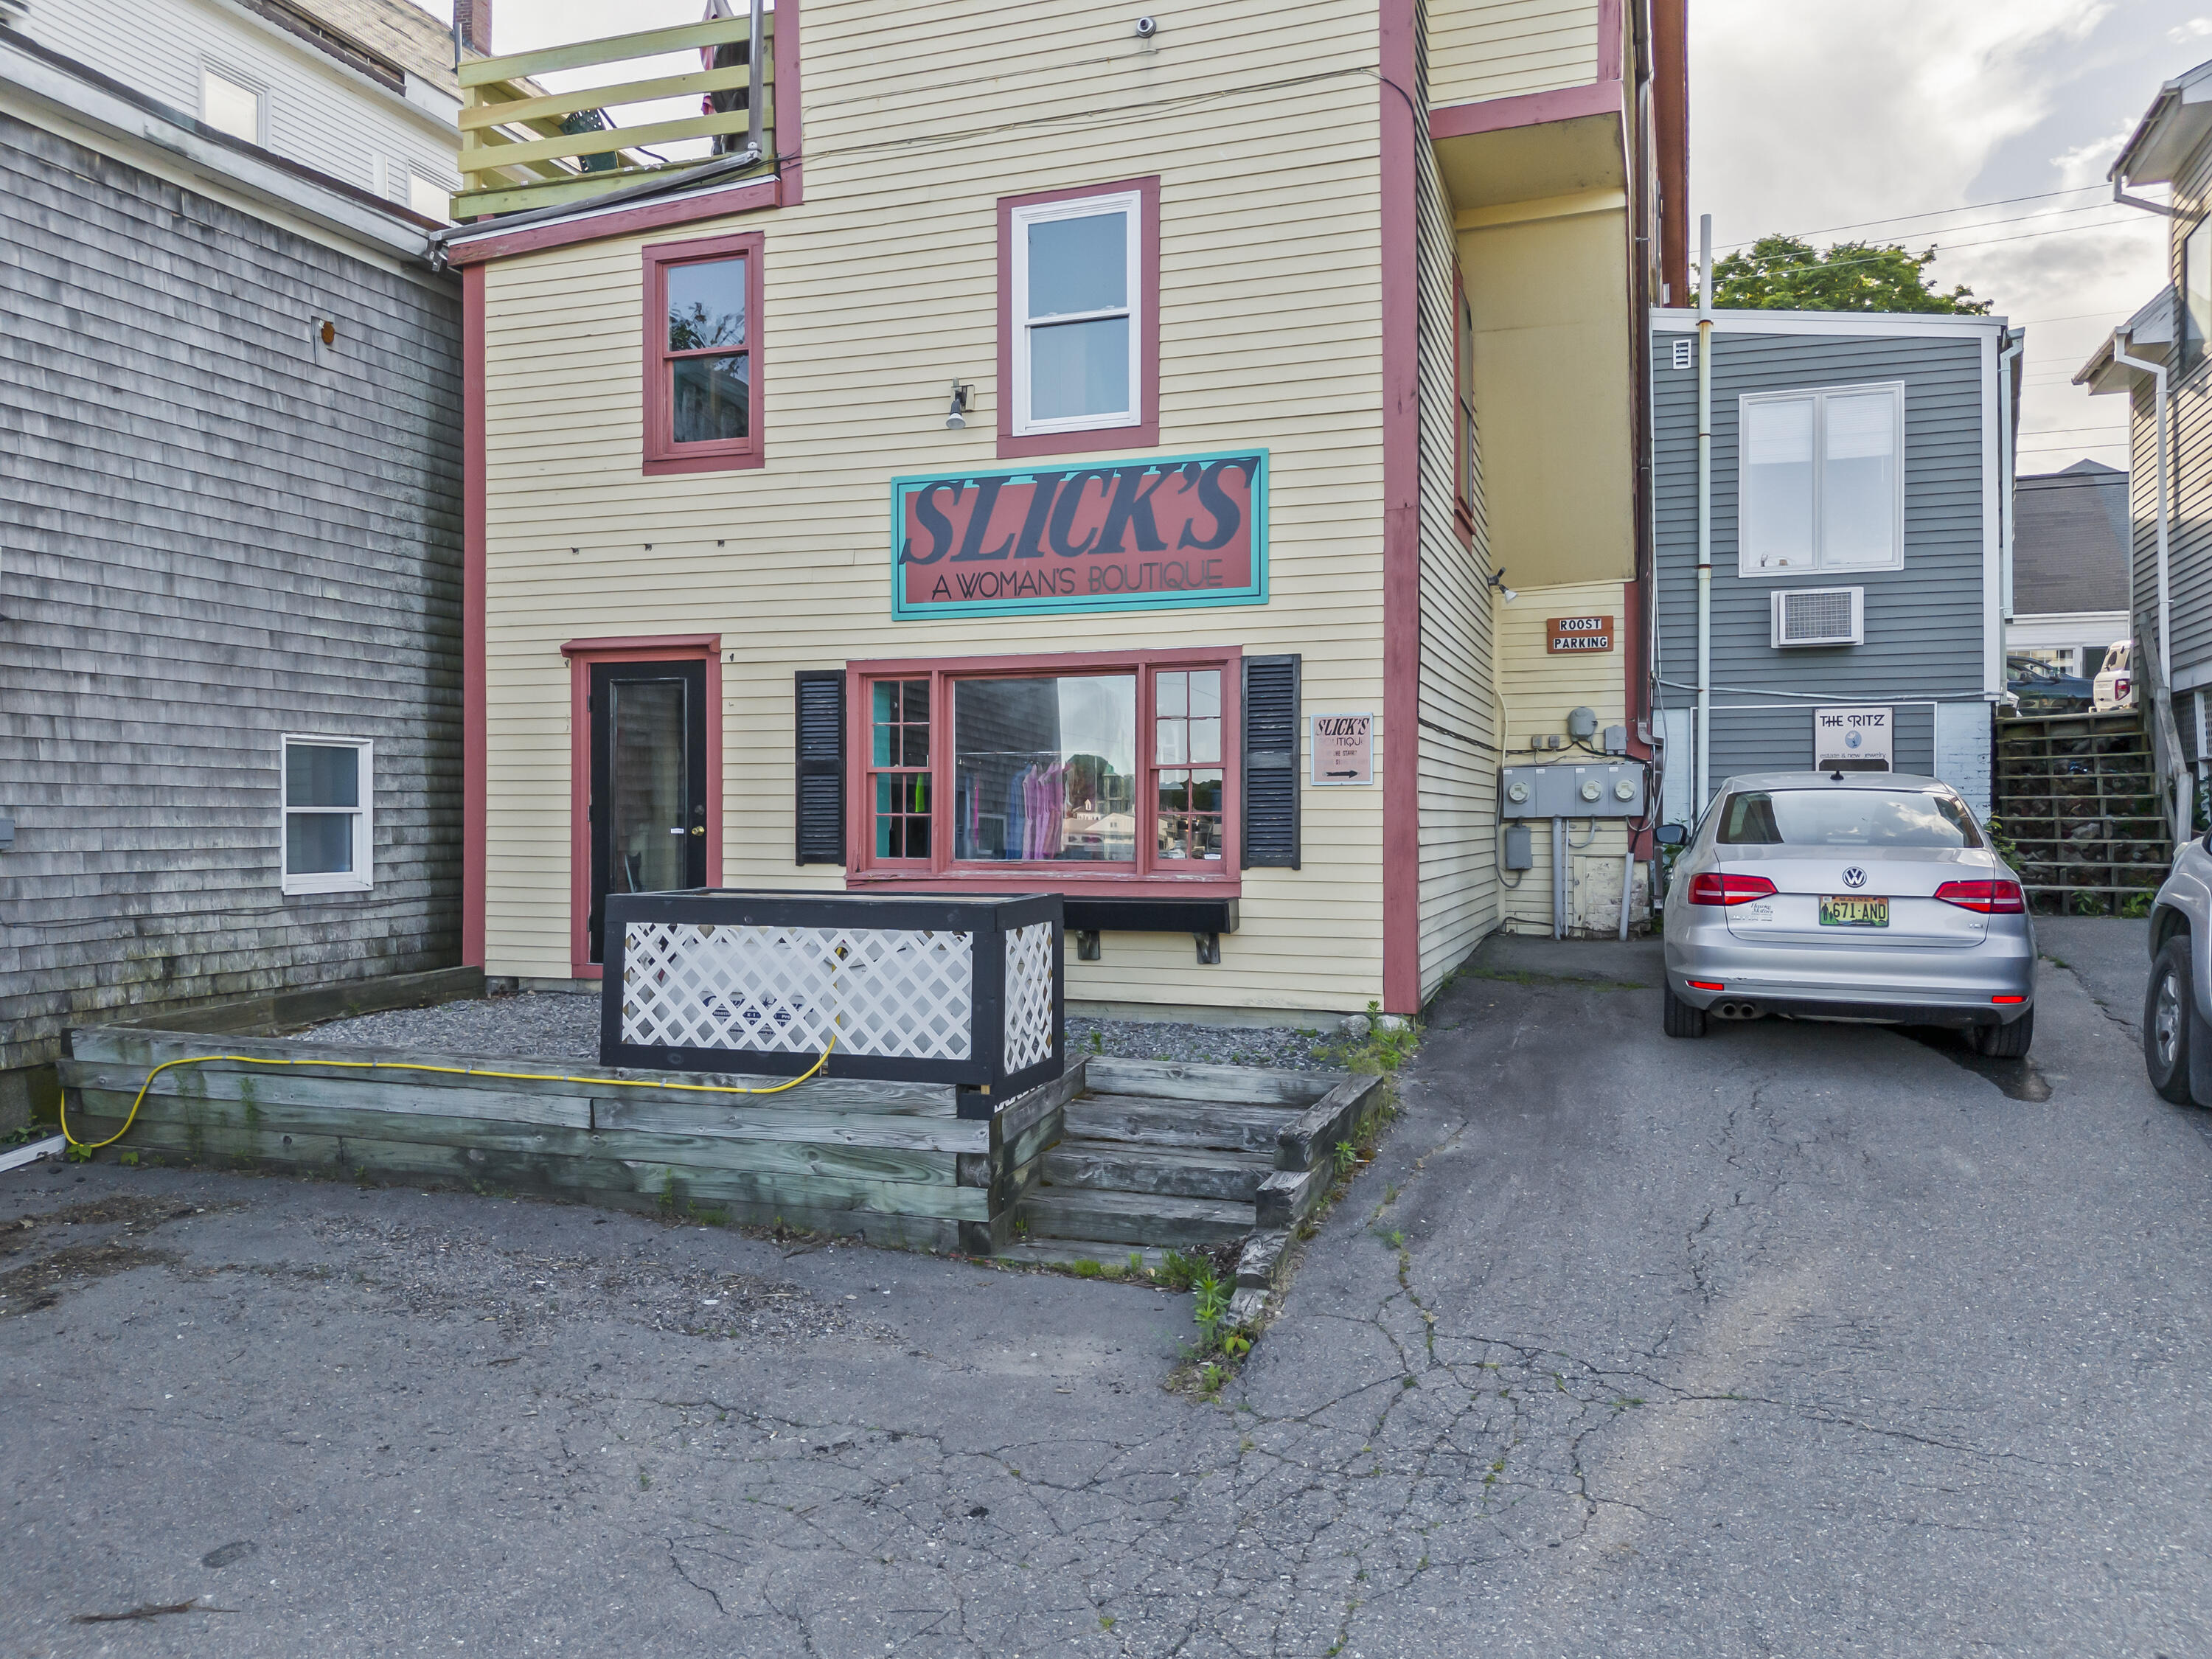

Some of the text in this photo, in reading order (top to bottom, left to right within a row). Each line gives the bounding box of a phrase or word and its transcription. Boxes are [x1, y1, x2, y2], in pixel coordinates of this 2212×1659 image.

[899, 456, 1260, 566] SLICK'S
[932, 559, 1223, 600] A WOMAN'S BOUTIQUE
[1560, 619, 1601, 630] ROOST
[1554, 637, 1607, 649] PARKING
[1315, 717, 1370, 736] SLICK'S
[1819, 714, 1885, 728] THE RITZ
